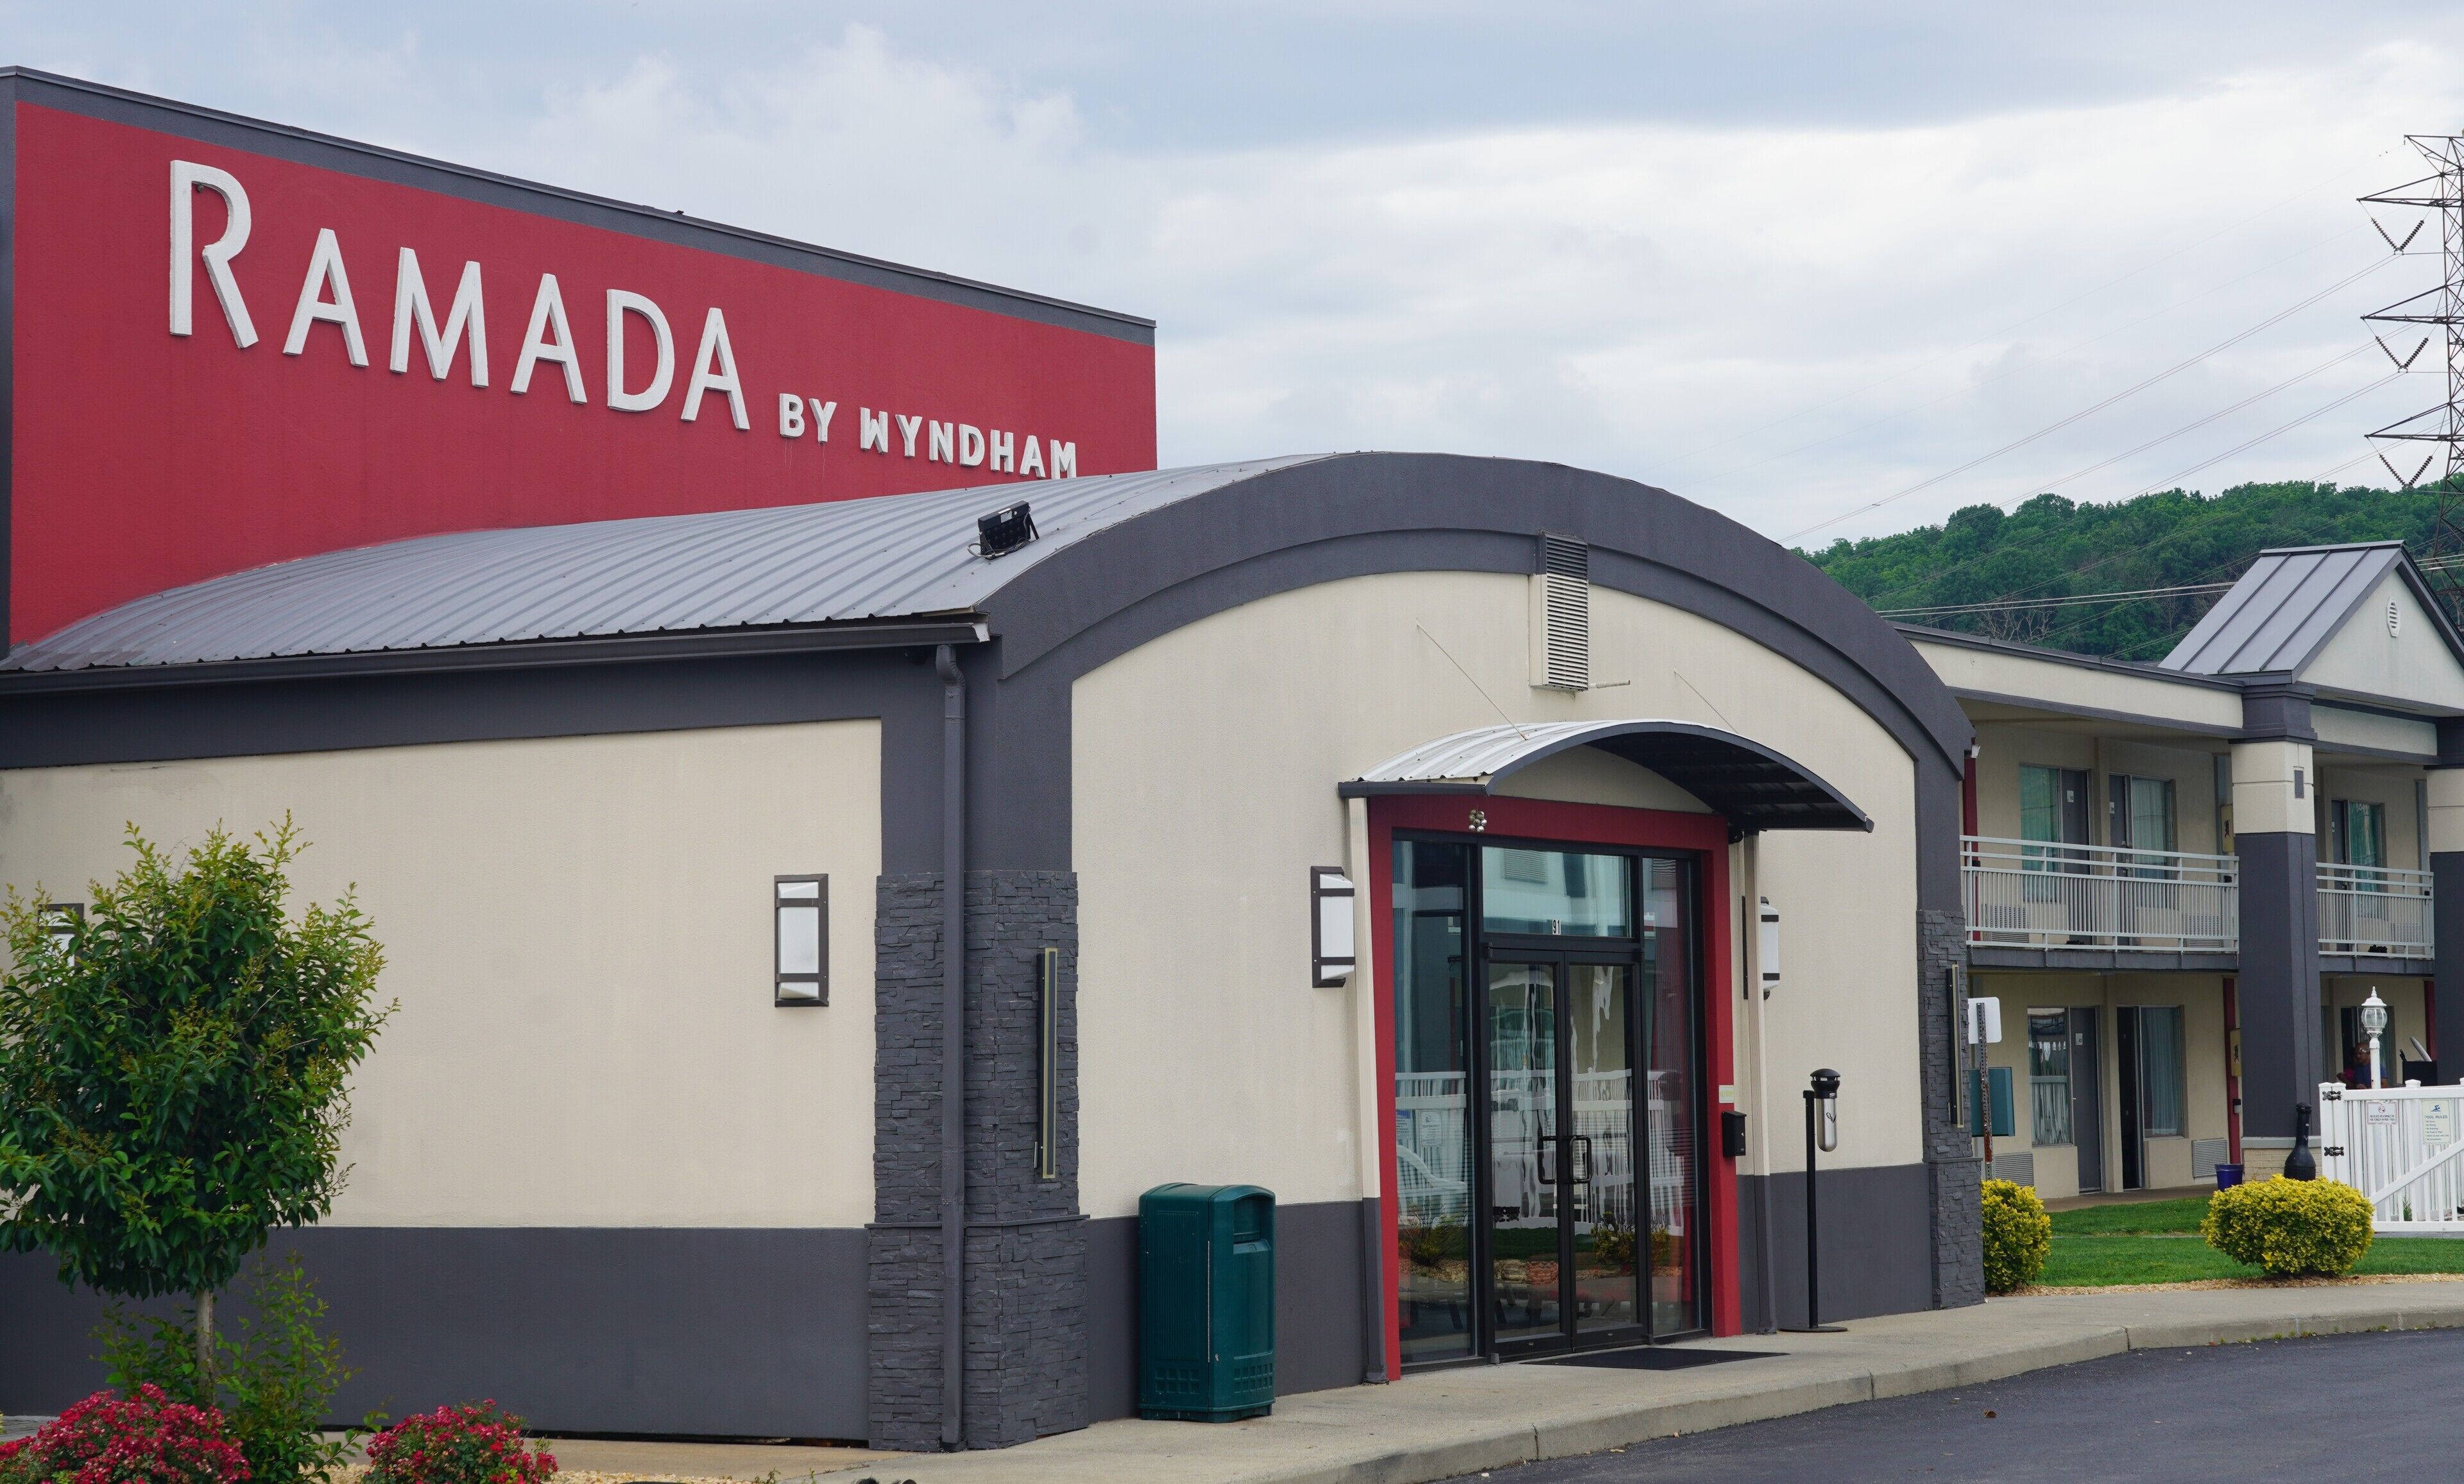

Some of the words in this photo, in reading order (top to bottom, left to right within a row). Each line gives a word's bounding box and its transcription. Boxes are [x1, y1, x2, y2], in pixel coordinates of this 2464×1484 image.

[169, 159, 751, 431] RAMADA
[779, 393, 837, 443] BY
[860, 407, 1077, 479] WYNDHAM
[1553, 919, 1560, 934] 91
